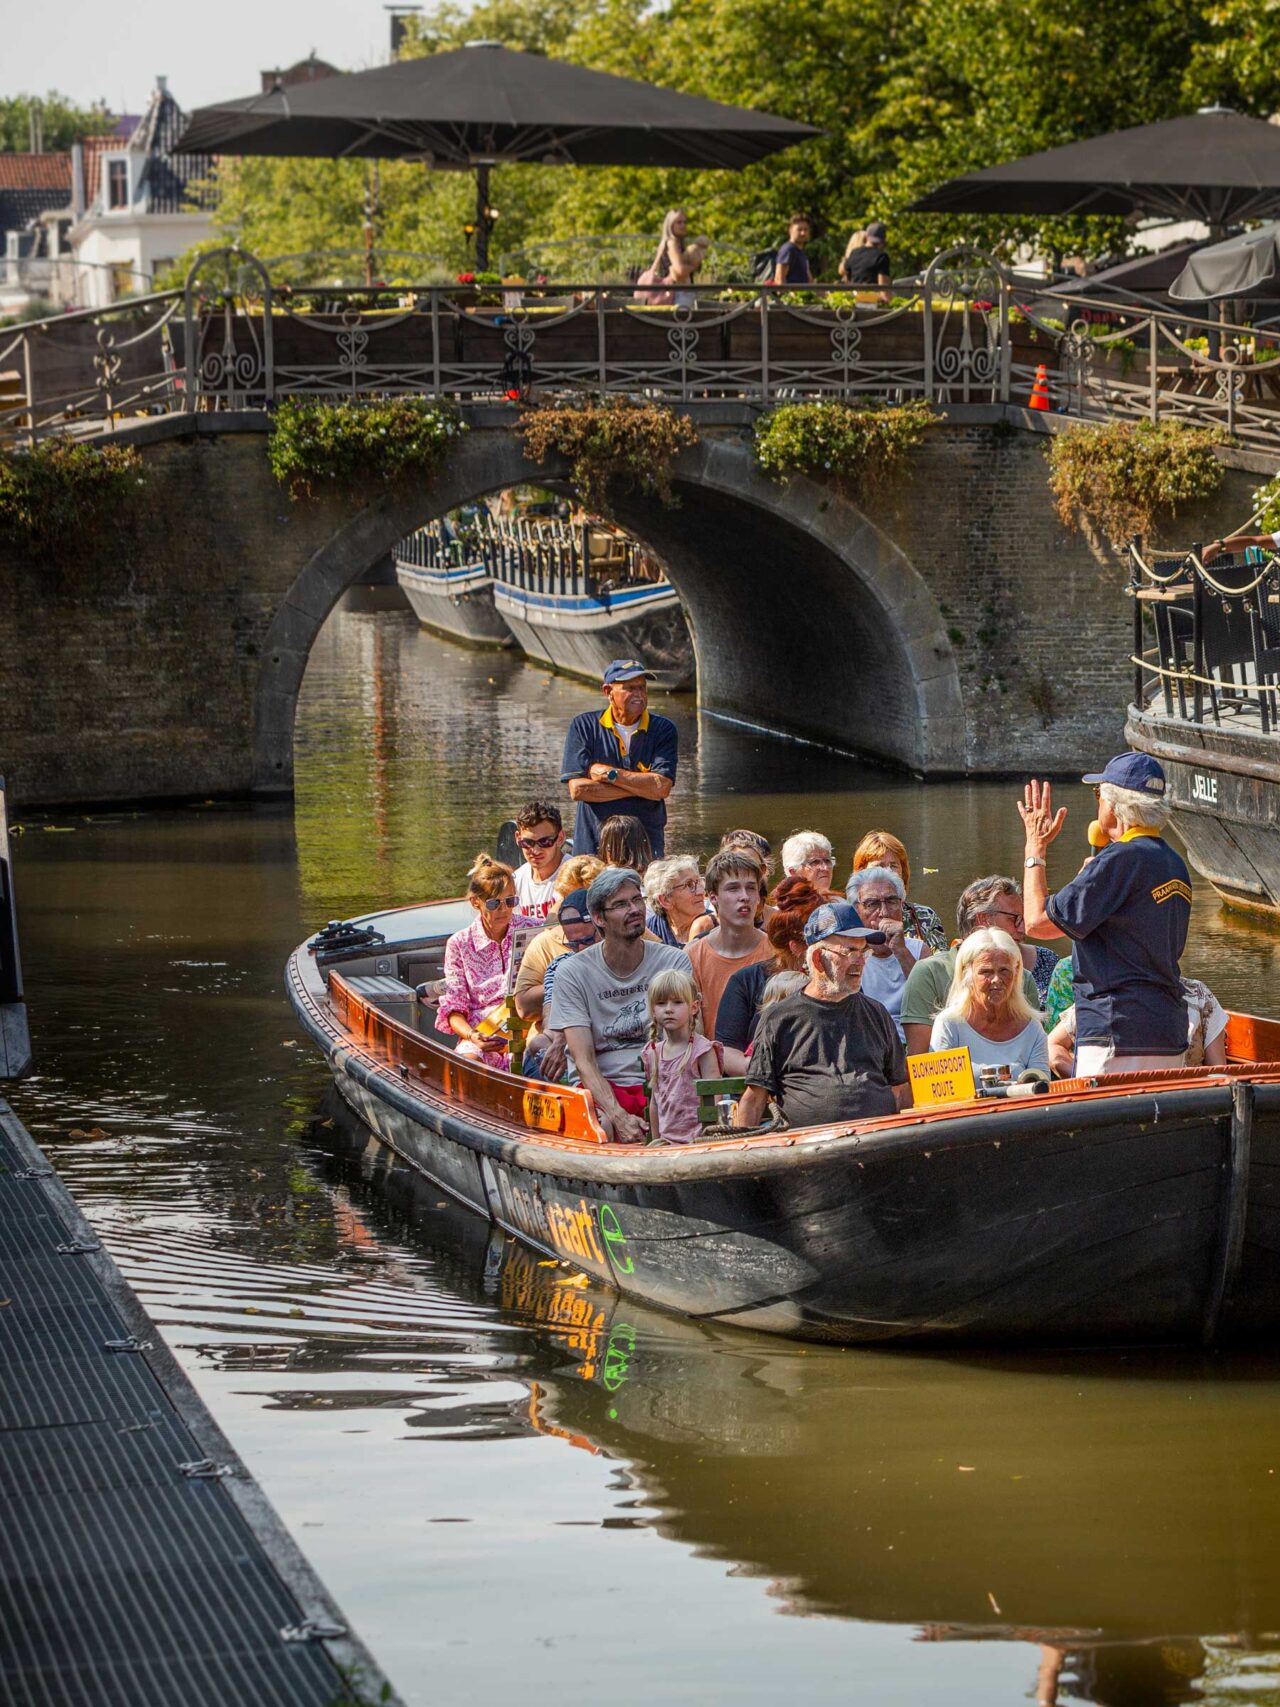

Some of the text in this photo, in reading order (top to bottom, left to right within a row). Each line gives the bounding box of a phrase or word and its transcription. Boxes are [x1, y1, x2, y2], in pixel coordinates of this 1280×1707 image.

[1192, 774, 1217, 803] JELLE
[911, 1055, 967, 1079] BLOKHUISPOORT
[931, 1080, 955, 1098] ROUTE
